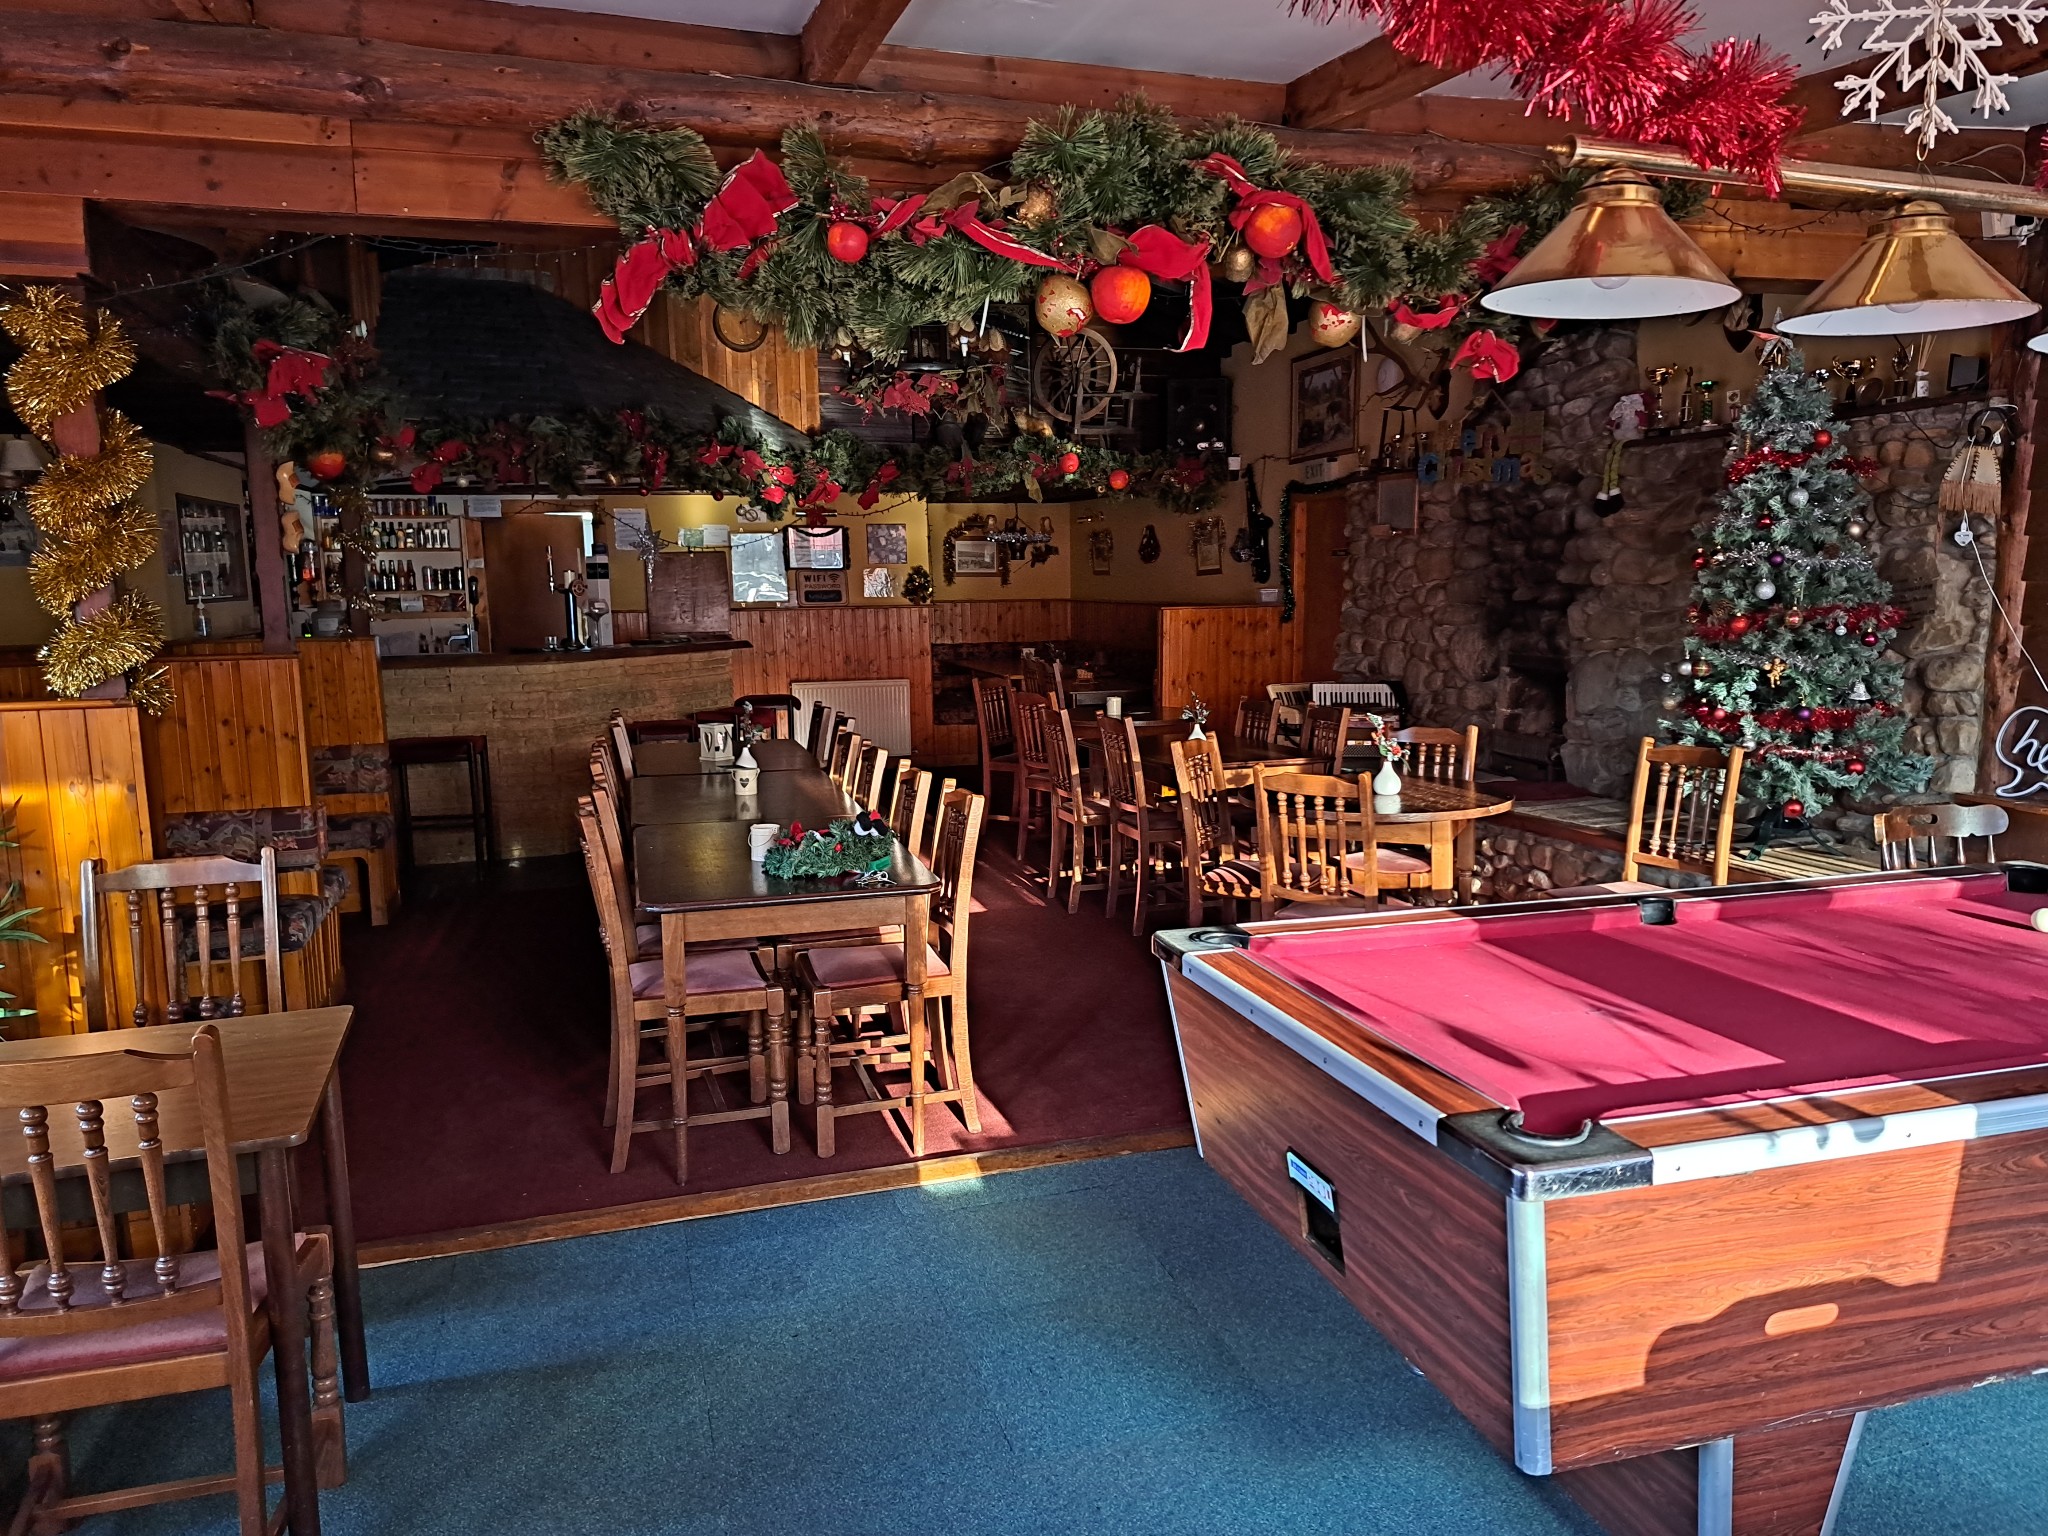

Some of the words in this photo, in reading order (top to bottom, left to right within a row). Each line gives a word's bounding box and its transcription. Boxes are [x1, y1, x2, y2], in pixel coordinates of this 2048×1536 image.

[1305, 463, 1323, 480] EXIT
[1417, 453, 1553, 486] Christmas
[803, 574, 826, 582] WIFI
